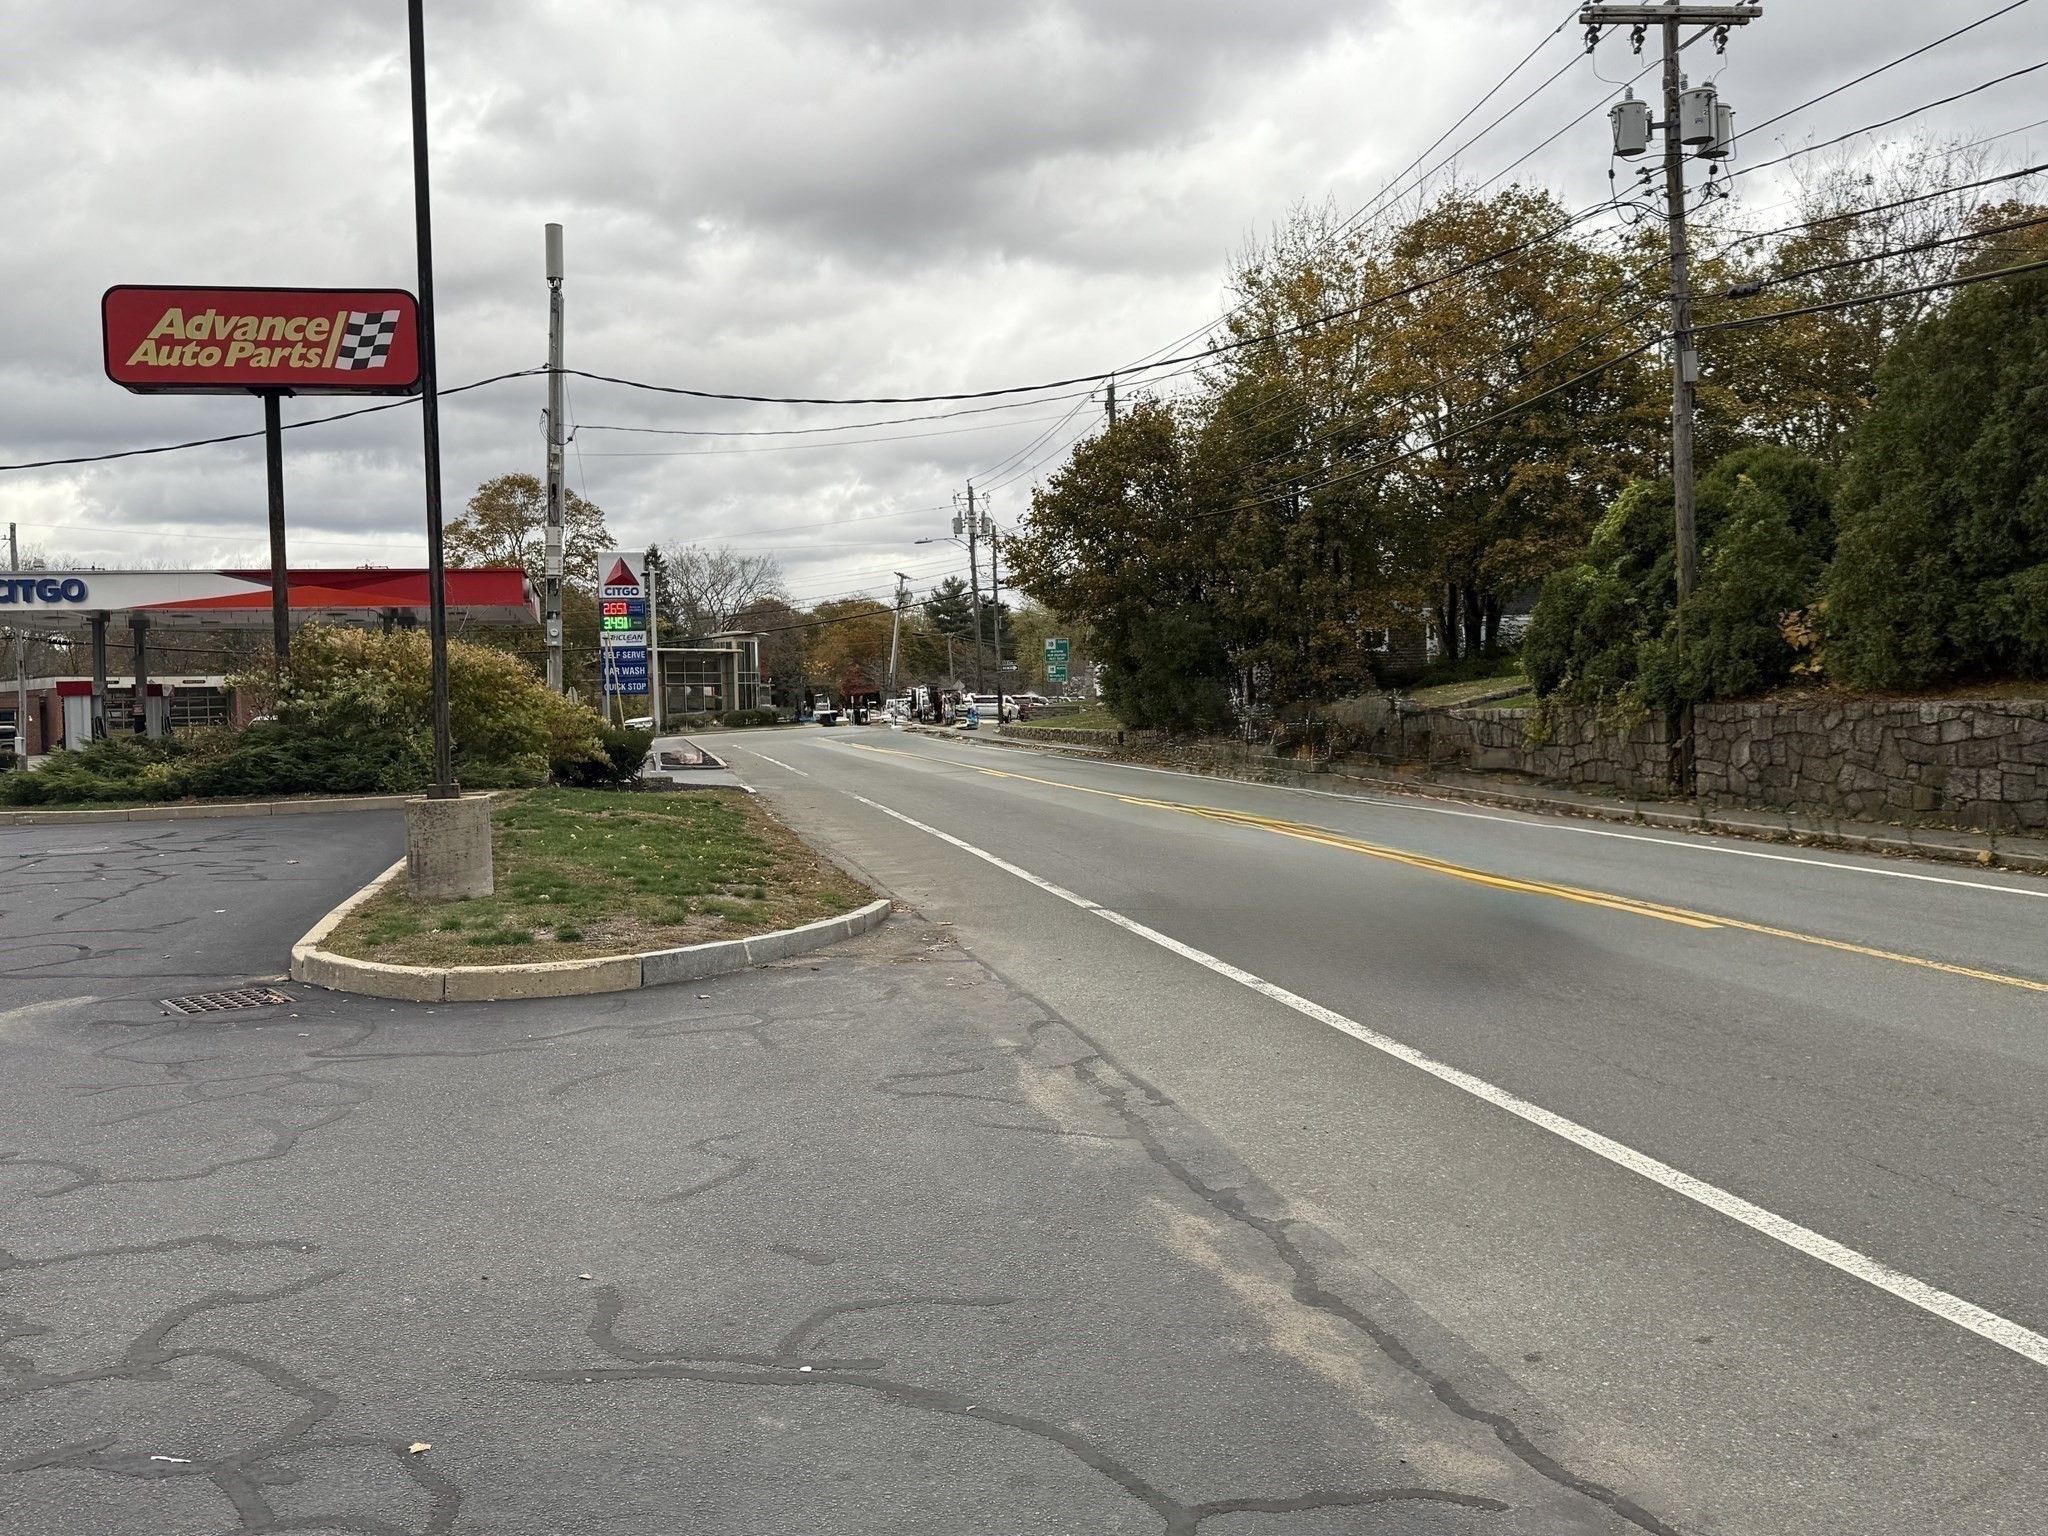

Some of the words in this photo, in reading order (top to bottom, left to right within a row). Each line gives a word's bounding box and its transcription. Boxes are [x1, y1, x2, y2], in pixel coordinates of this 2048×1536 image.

[147, 308, 330, 341] Advance
[125, 339, 222, 367] Auto
[224, 341, 323, 368] Parts
[604, 587, 639, 596] CITGO
[603, 651, 621, 659] SELF
[622, 651, 645, 659] SERVE
[621, 667, 645, 675] WASH
[627, 683, 646, 691] STOP
